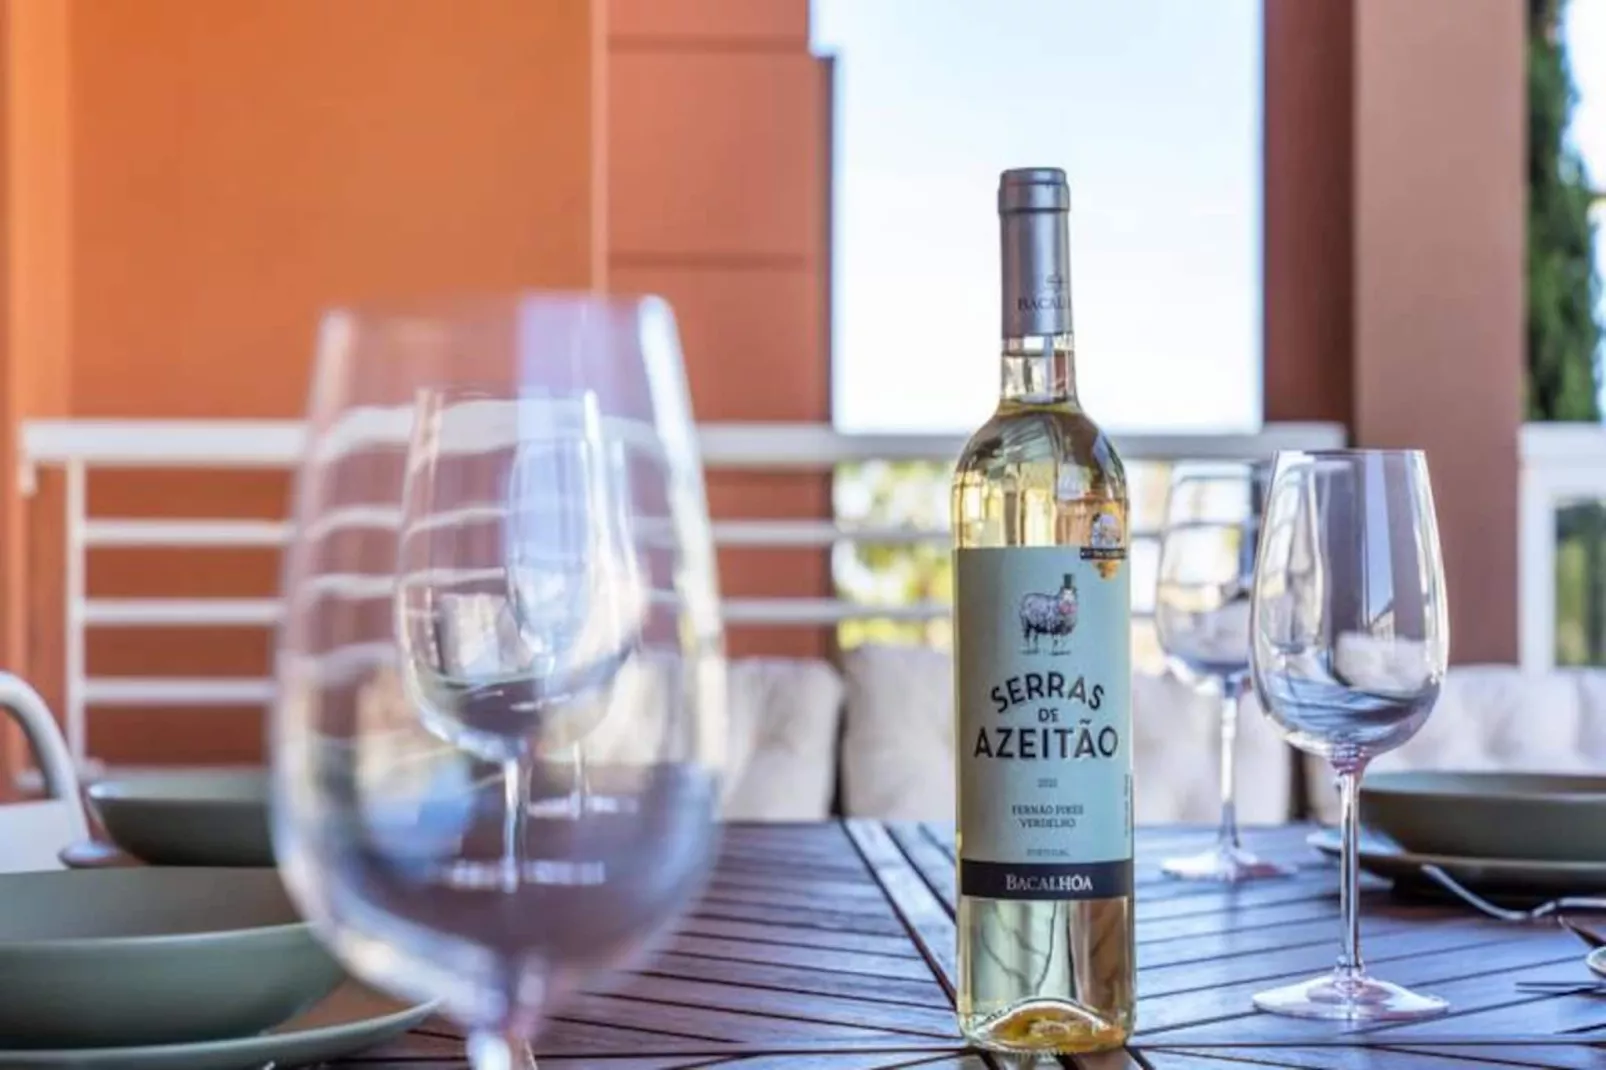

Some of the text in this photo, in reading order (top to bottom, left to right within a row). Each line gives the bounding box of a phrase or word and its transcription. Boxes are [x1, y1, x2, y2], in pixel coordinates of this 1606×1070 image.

[990, 671, 1105, 713] SERRAS
[1038, 708, 1060, 722] DE
[973, 718, 1119, 758] AZEITÃO
